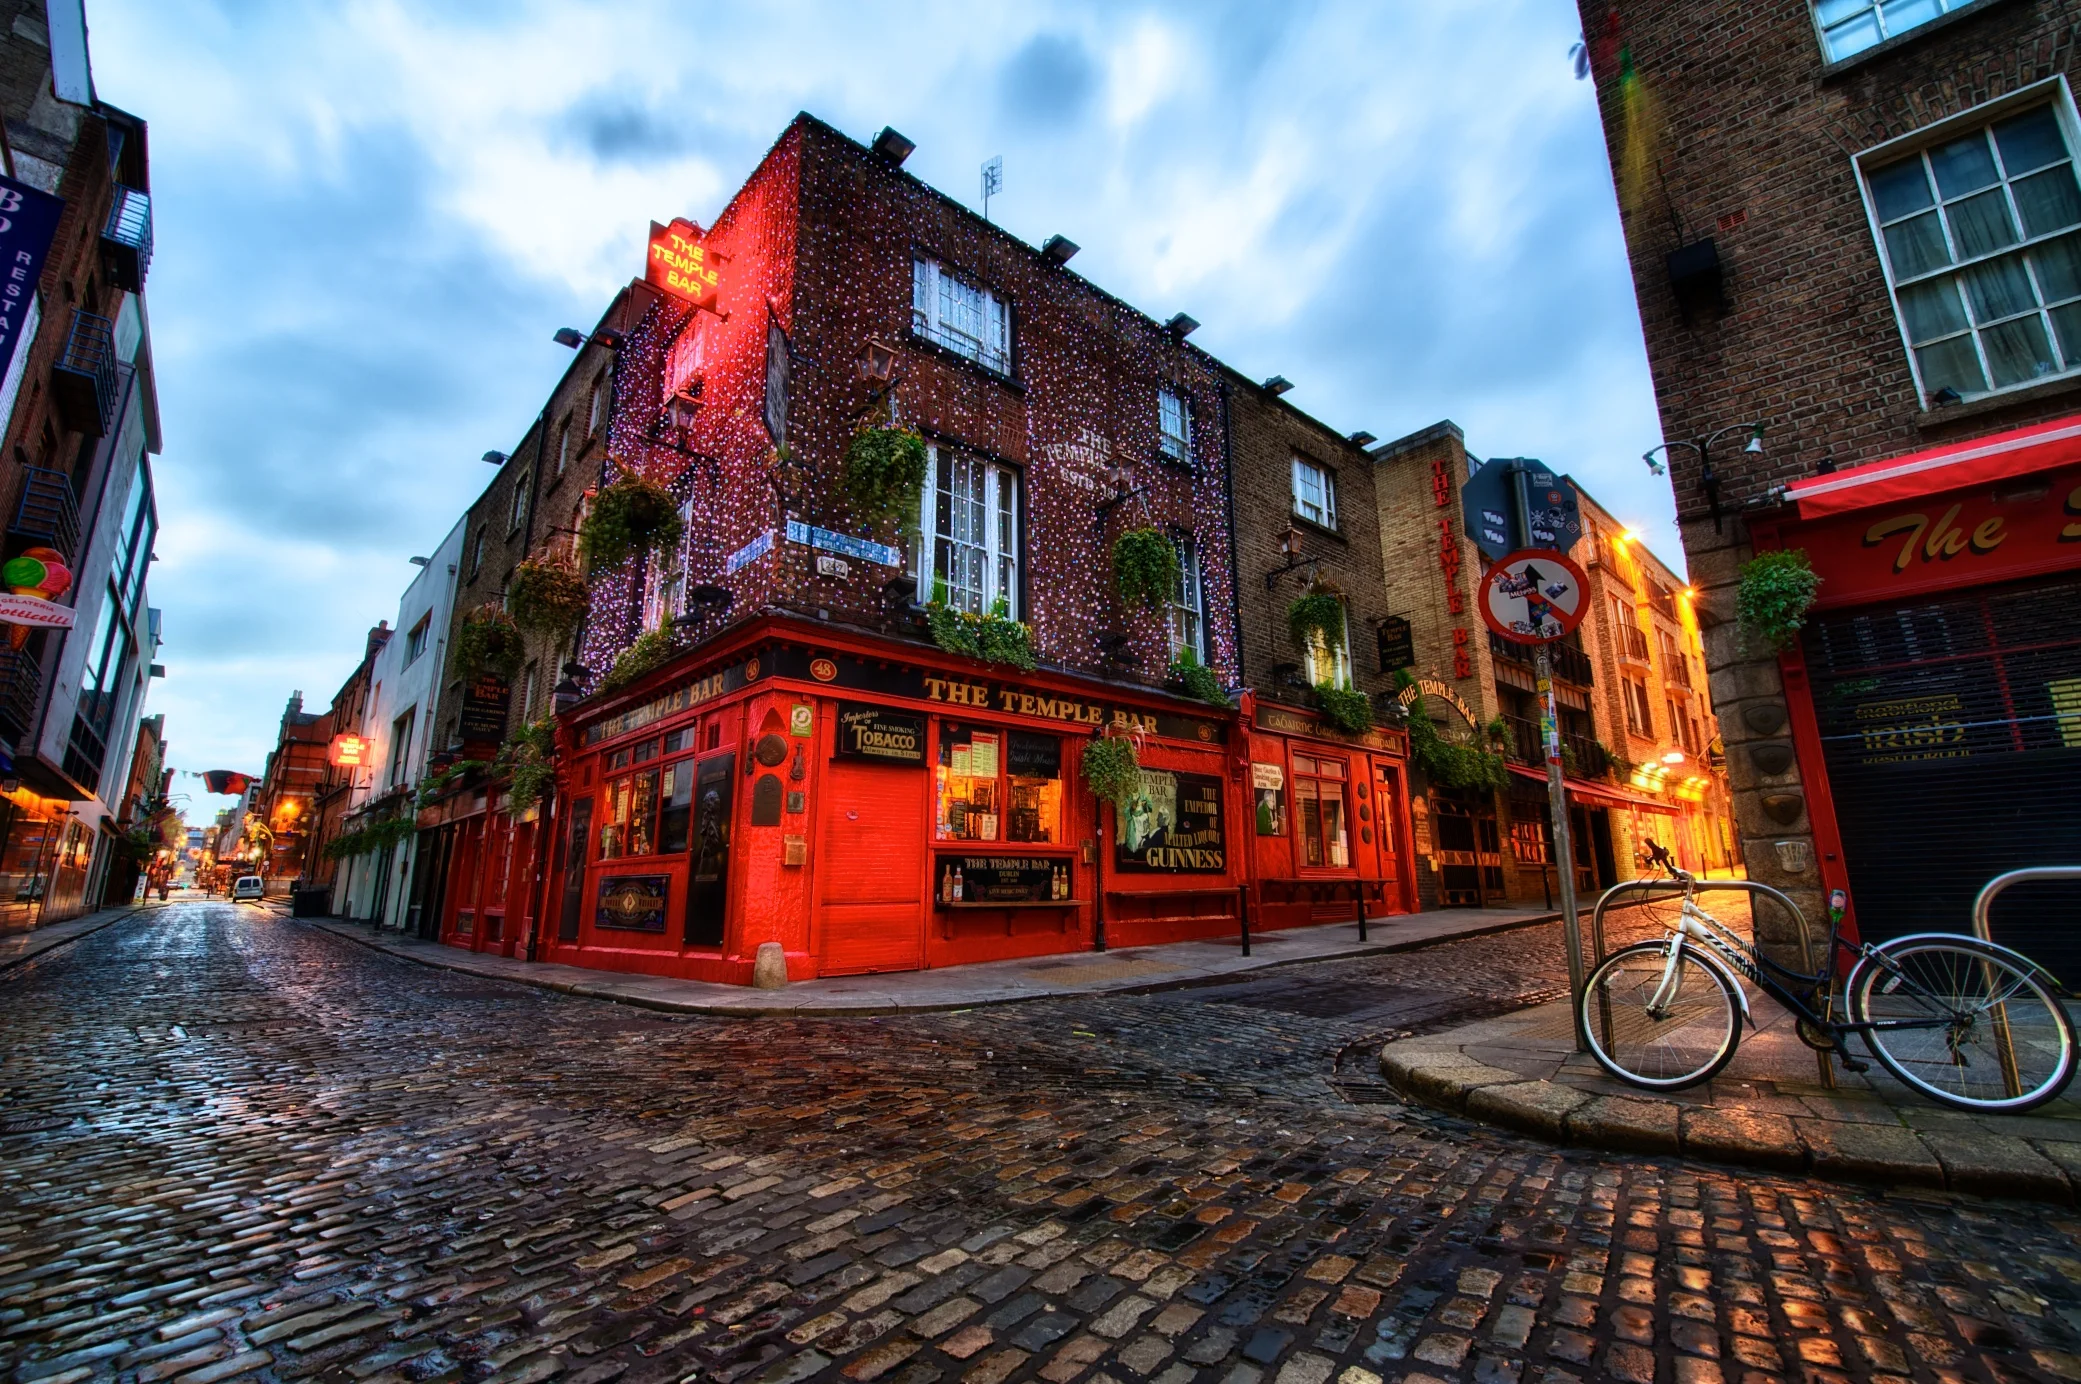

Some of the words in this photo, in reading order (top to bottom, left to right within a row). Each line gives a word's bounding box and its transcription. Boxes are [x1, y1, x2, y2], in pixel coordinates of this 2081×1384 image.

[670, 234, 705, 262] THE
[652, 244, 719, 286] TEMPLE
[667, 271, 702, 297] BAR
[0, 250, 32, 345] RESTA
[1079, 426, 1112, 455] THE
[1041, 442, 1110, 468] TEMPLE
[1431, 459, 1450, 507] THE
[1864, 503, 2008, 570] The
[1438, 518, 1463, 614] TEMPLE
[0, 604, 69, 625] otticelli
[1, 598, 55, 612] GELATERIA
[1452, 628, 1472, 679] BAR
[814, 661, 831, 677] 48
[601, 714, 625, 738] THE
[630, 692, 683, 729] TEMPLE
[689, 673, 724, 705] BAR
[924, 677, 989, 708] THE
[1000, 690, 1103, 725] TEMPLE
[1113, 709, 1159, 735] BAR
[1398, 683, 1419, 708] THE
[1417, 679, 1455, 703] TEMPLE
[1457, 696, 1477, 730] BAR
[841, 710, 879, 727] Importers
[873, 723, 888, 733] FINE
[888, 725, 916, 735] SMOKING
[851, 724, 917, 750] TOBACCO
[863, 746, 889, 756] Always
[900, 750, 921, 759] Stock
[1149, 785, 1168, 798] BAR
[1202, 787, 1217, 801] THE
[1184, 800, 1218, 815] EMPEROR
[1209, 816, 1217, 829] OF
[1164, 831, 1194, 847] MALTED
[1194, 829, 1220, 847] LIQUORS
[965, 857, 988, 870] THE
[989, 858, 1029, 871] TEMPLE
[1031, 859, 1051, 871] BAR
[1146, 847, 1223, 869] GUINNESS
